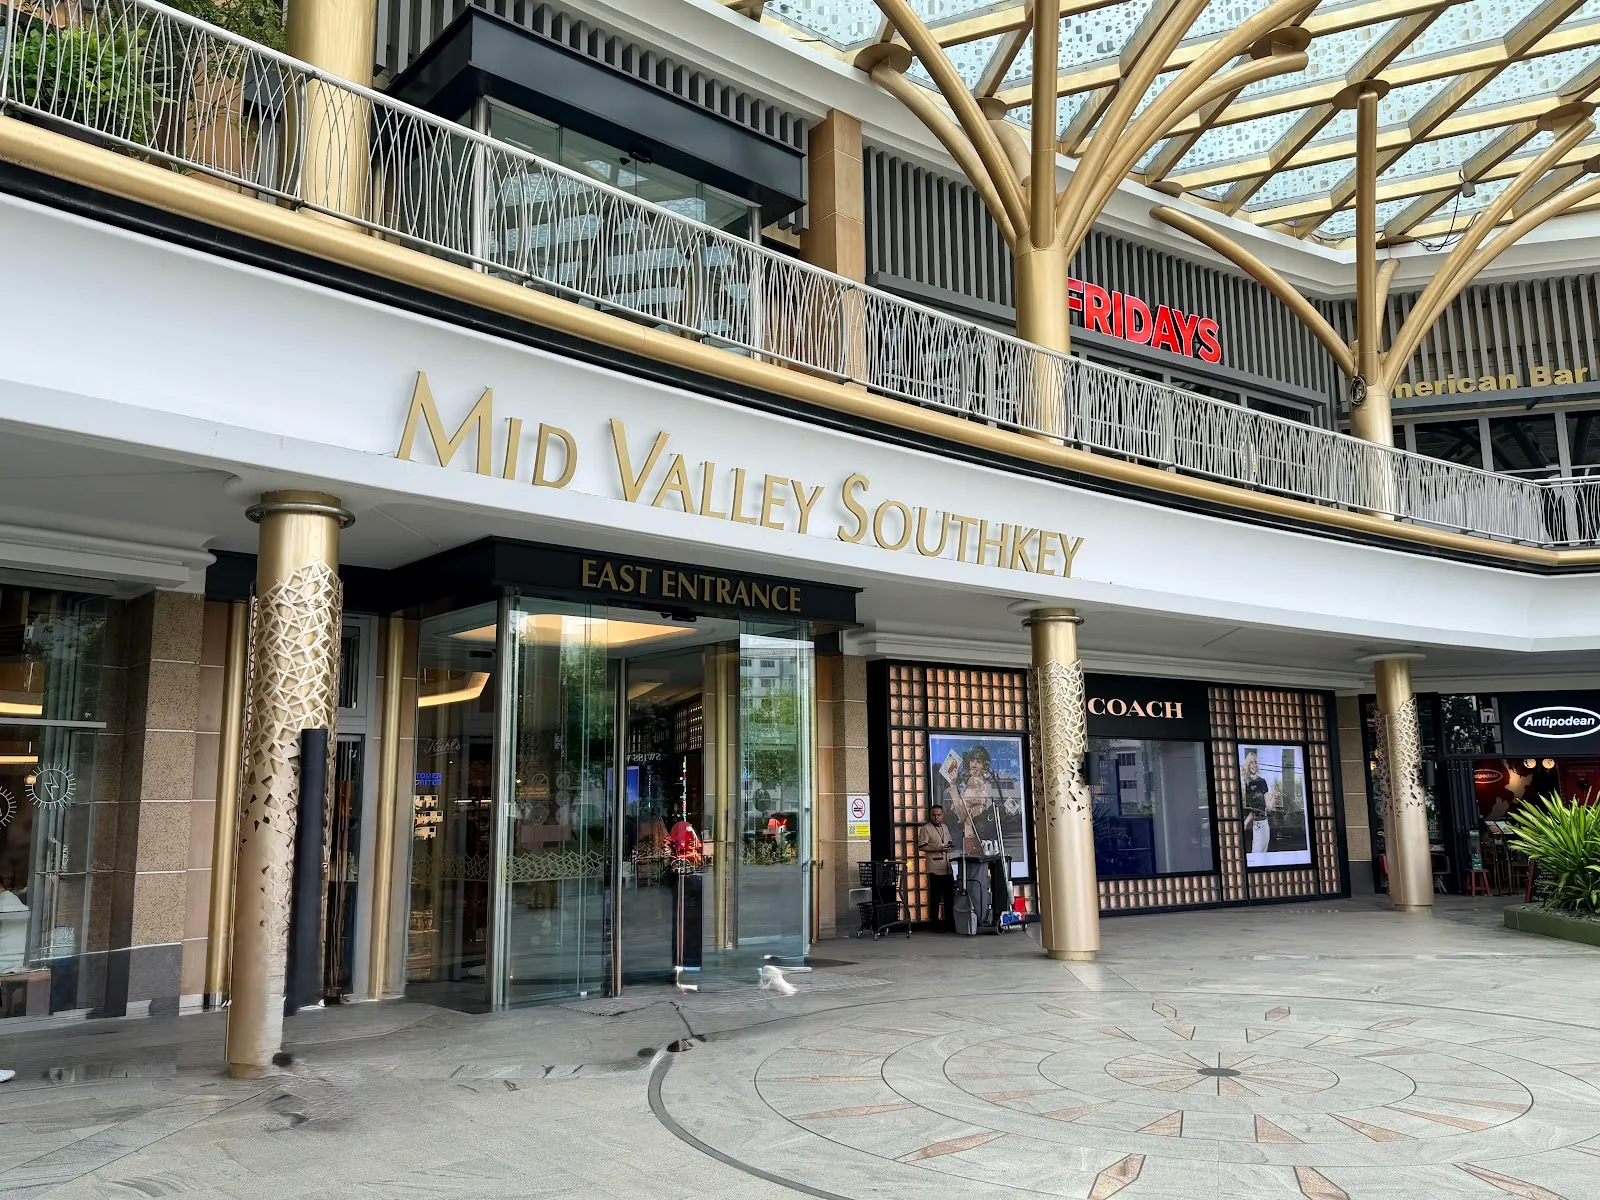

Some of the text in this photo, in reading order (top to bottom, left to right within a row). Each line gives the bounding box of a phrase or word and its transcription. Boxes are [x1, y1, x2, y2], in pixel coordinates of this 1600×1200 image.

[1068, 277, 1222, 364] FRIDAYS
[1393, 366, 1588, 398] merican Bar
[396, 371, 1084, 578] MID VALLEY SOUTHKEY
[581, 558, 801, 613] EAST ENTRANCE
[1087, 697, 1184, 719] COACH
[1524, 716, 1596, 729] Antipodean
